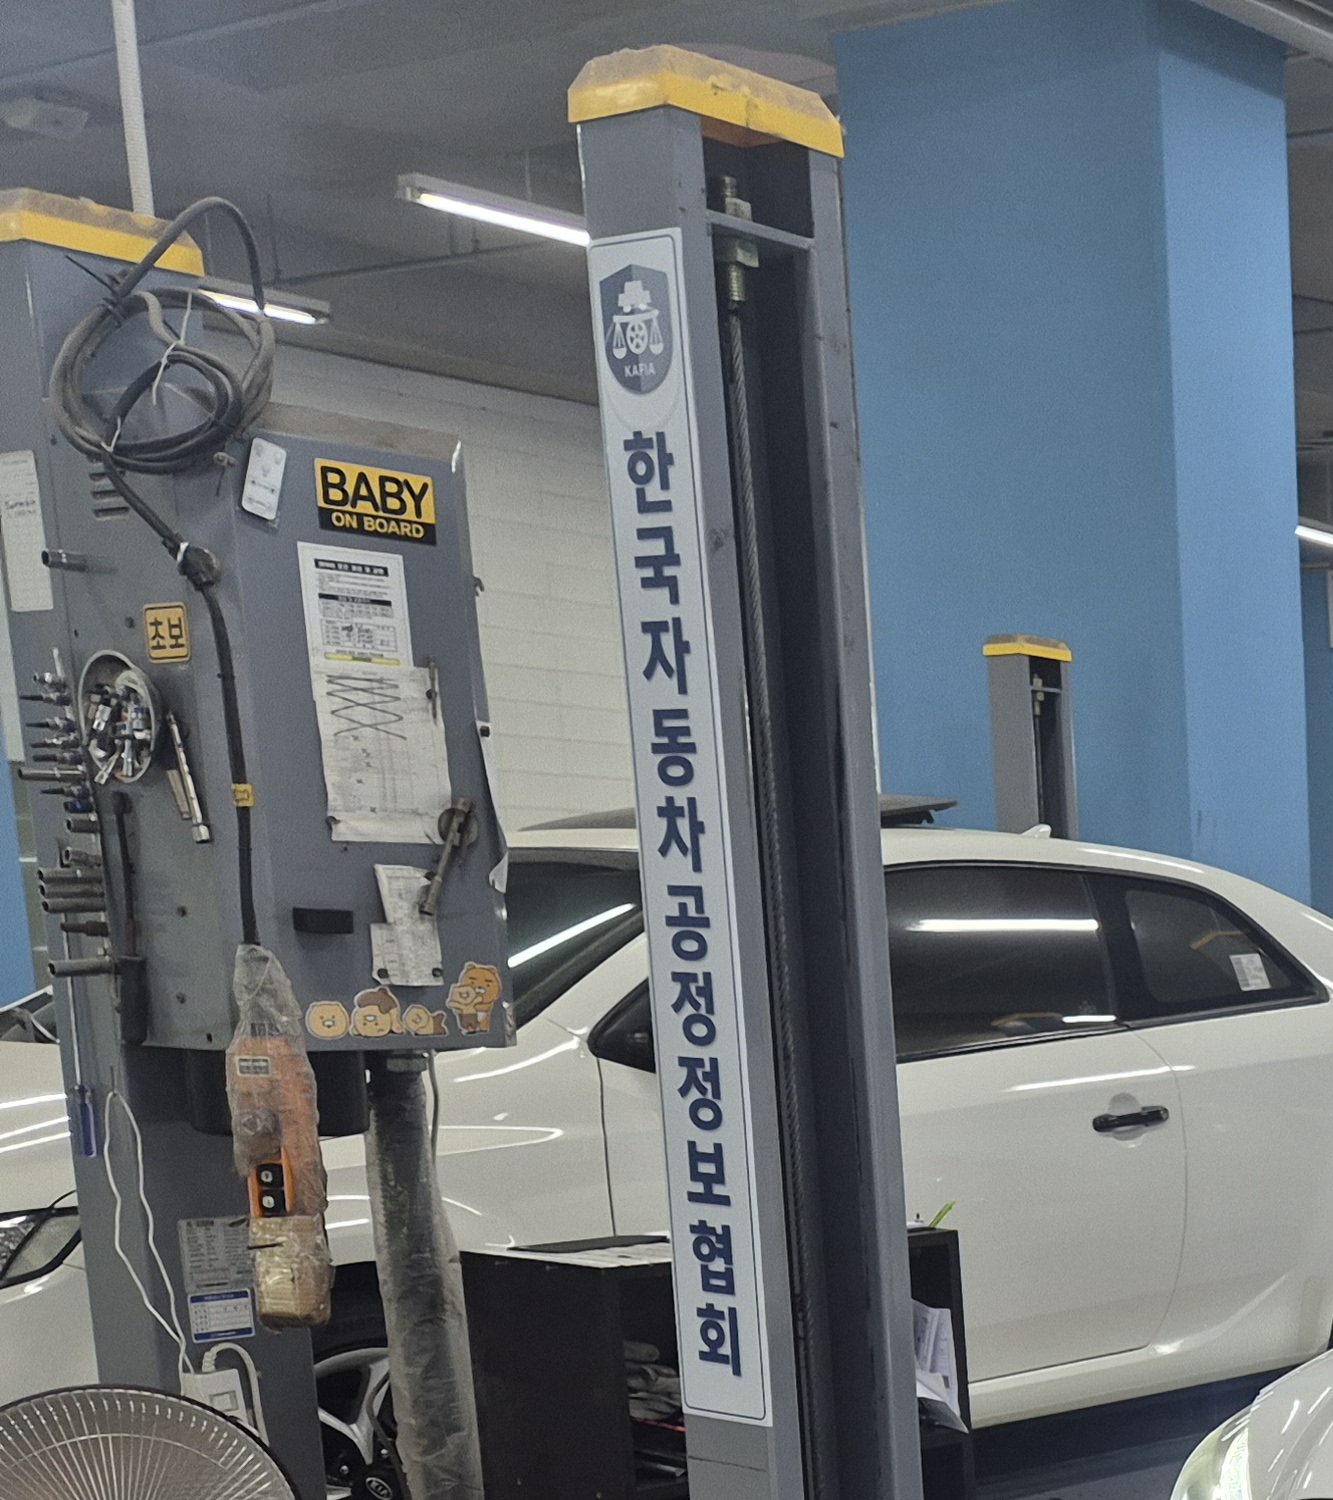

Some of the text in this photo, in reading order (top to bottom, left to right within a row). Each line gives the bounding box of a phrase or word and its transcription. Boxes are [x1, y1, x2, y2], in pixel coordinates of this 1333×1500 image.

[624, 362, 656, 377] KAFIA
[320, 465, 428, 519] BABY
[331, 511, 425, 539] ON BOARD
[149, 616, 185, 650] 초보
[622, 430, 742, 1378] 한국자동차공정정보협회
